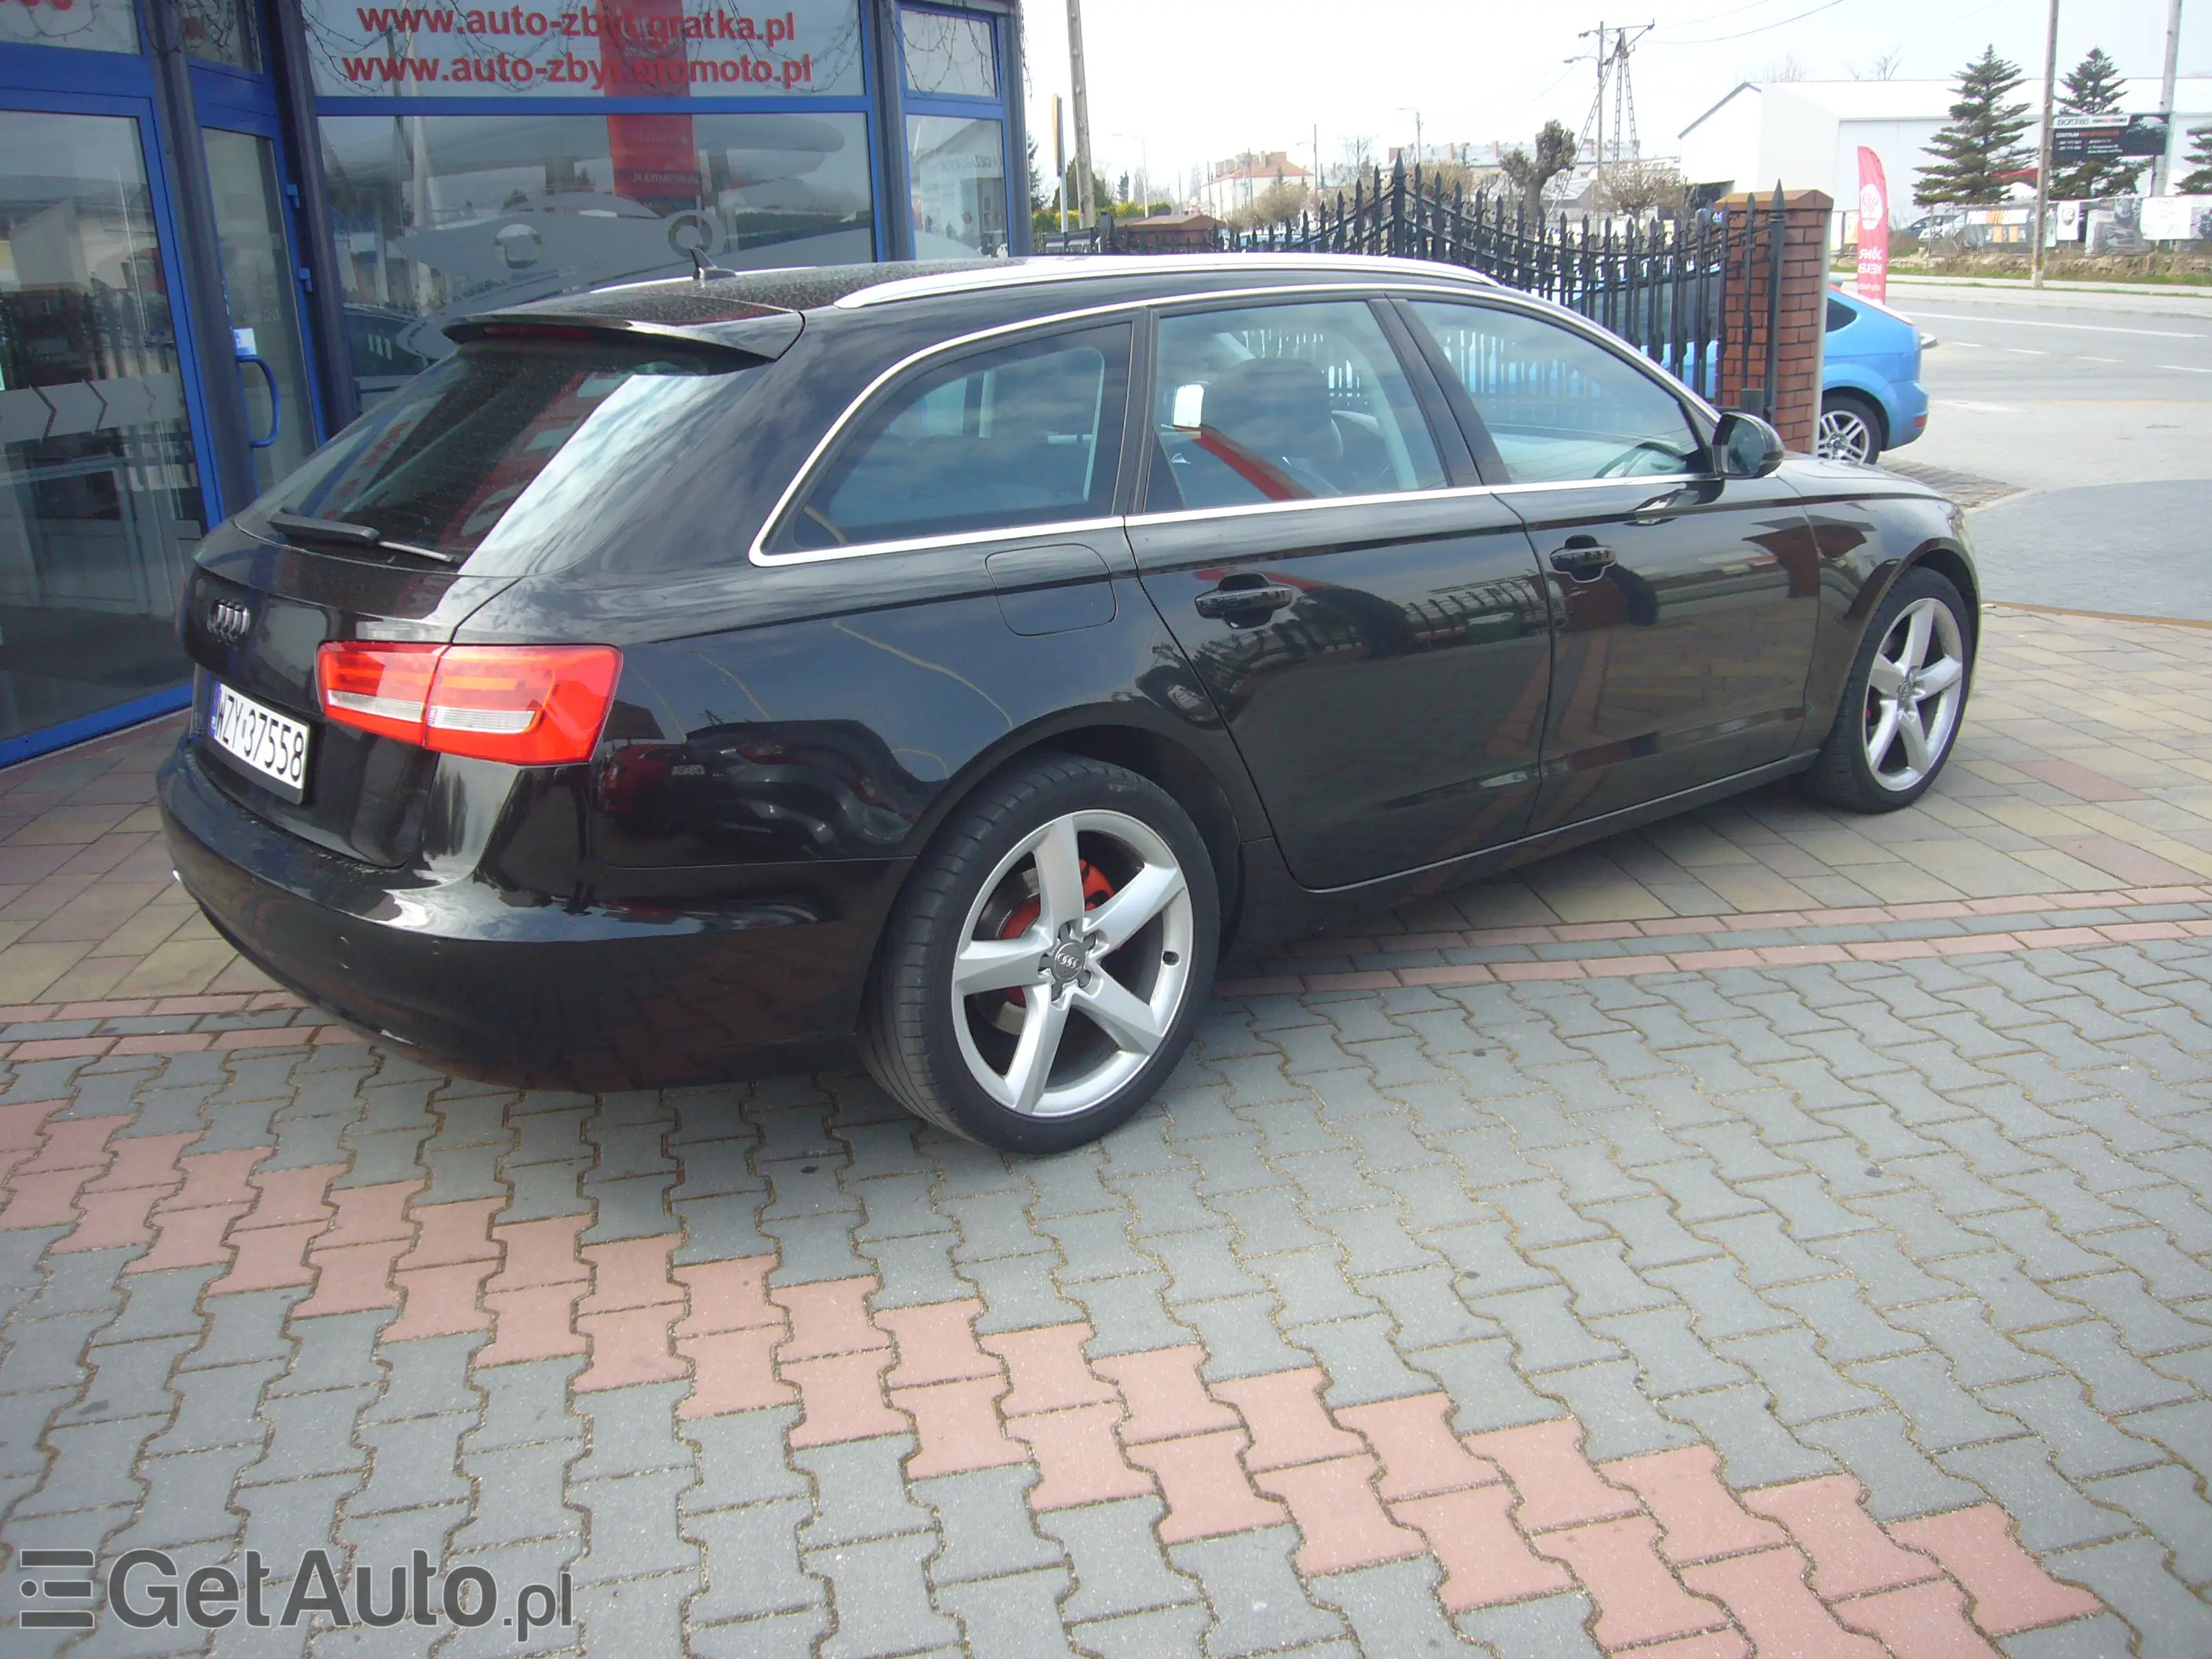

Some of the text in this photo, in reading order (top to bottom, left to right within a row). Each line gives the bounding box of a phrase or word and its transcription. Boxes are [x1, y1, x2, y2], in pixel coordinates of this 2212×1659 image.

[357, 5, 795, 47] www.auto-zbyt.gratka.pl
[341, 51, 812, 90] www.auto-zbyt.otomoto.pl
[244, 709, 305, 782] 37558
